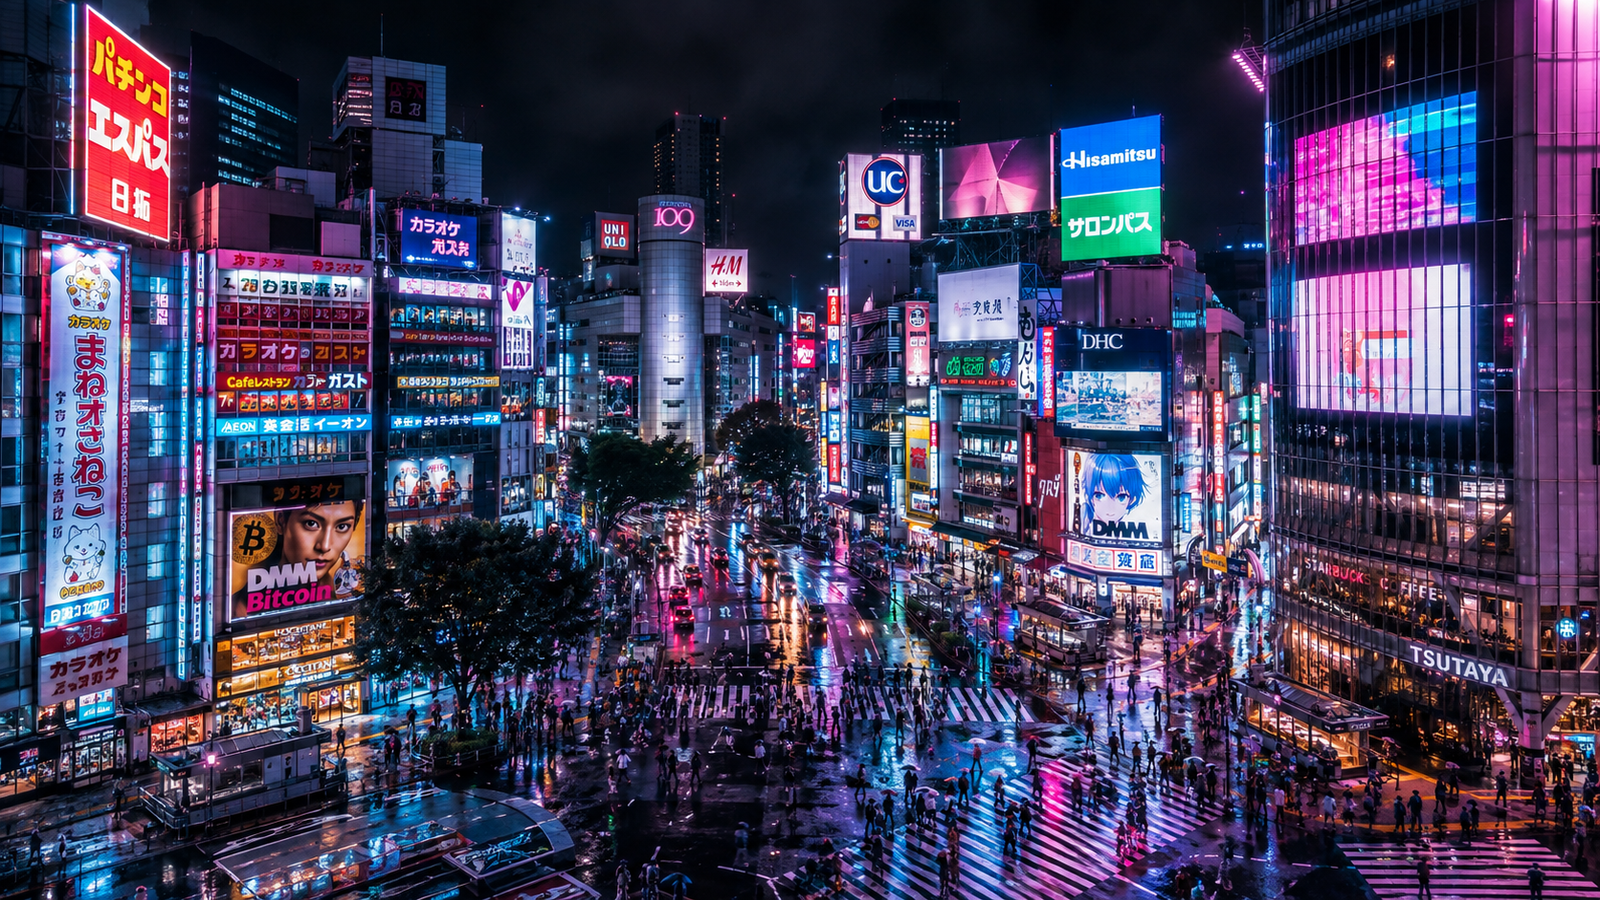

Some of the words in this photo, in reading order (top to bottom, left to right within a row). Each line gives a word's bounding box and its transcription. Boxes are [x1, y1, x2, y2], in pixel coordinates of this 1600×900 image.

[92, 36, 167, 118] パチンコ
[88, 97, 170, 179] エスパス
[1062, 147, 1157, 170] Hisamitsu
[867, 169, 905, 194] UC
[111, 178, 151, 222] 日拓
[410, 216, 461, 237] カラオケ
[604, 223, 625, 236] UNI
[653, 207, 696, 235] 109
[895, 219, 916, 228] VISA
[1068, 211, 1153, 239] サロンパス
[603, 235, 627, 249] QLO
[1081, 333, 1123, 350] DHC
[328, 372, 368, 389] ガスト
[221, 420, 257, 433] AEON
[1092, 518, 1150, 540] DMM
[247, 560, 319, 592] DMM
[246, 583, 332, 615] Bitcoin
[50, 647, 122, 680] カラオケ
[1409, 645, 1509, 688] TSUTAYA
